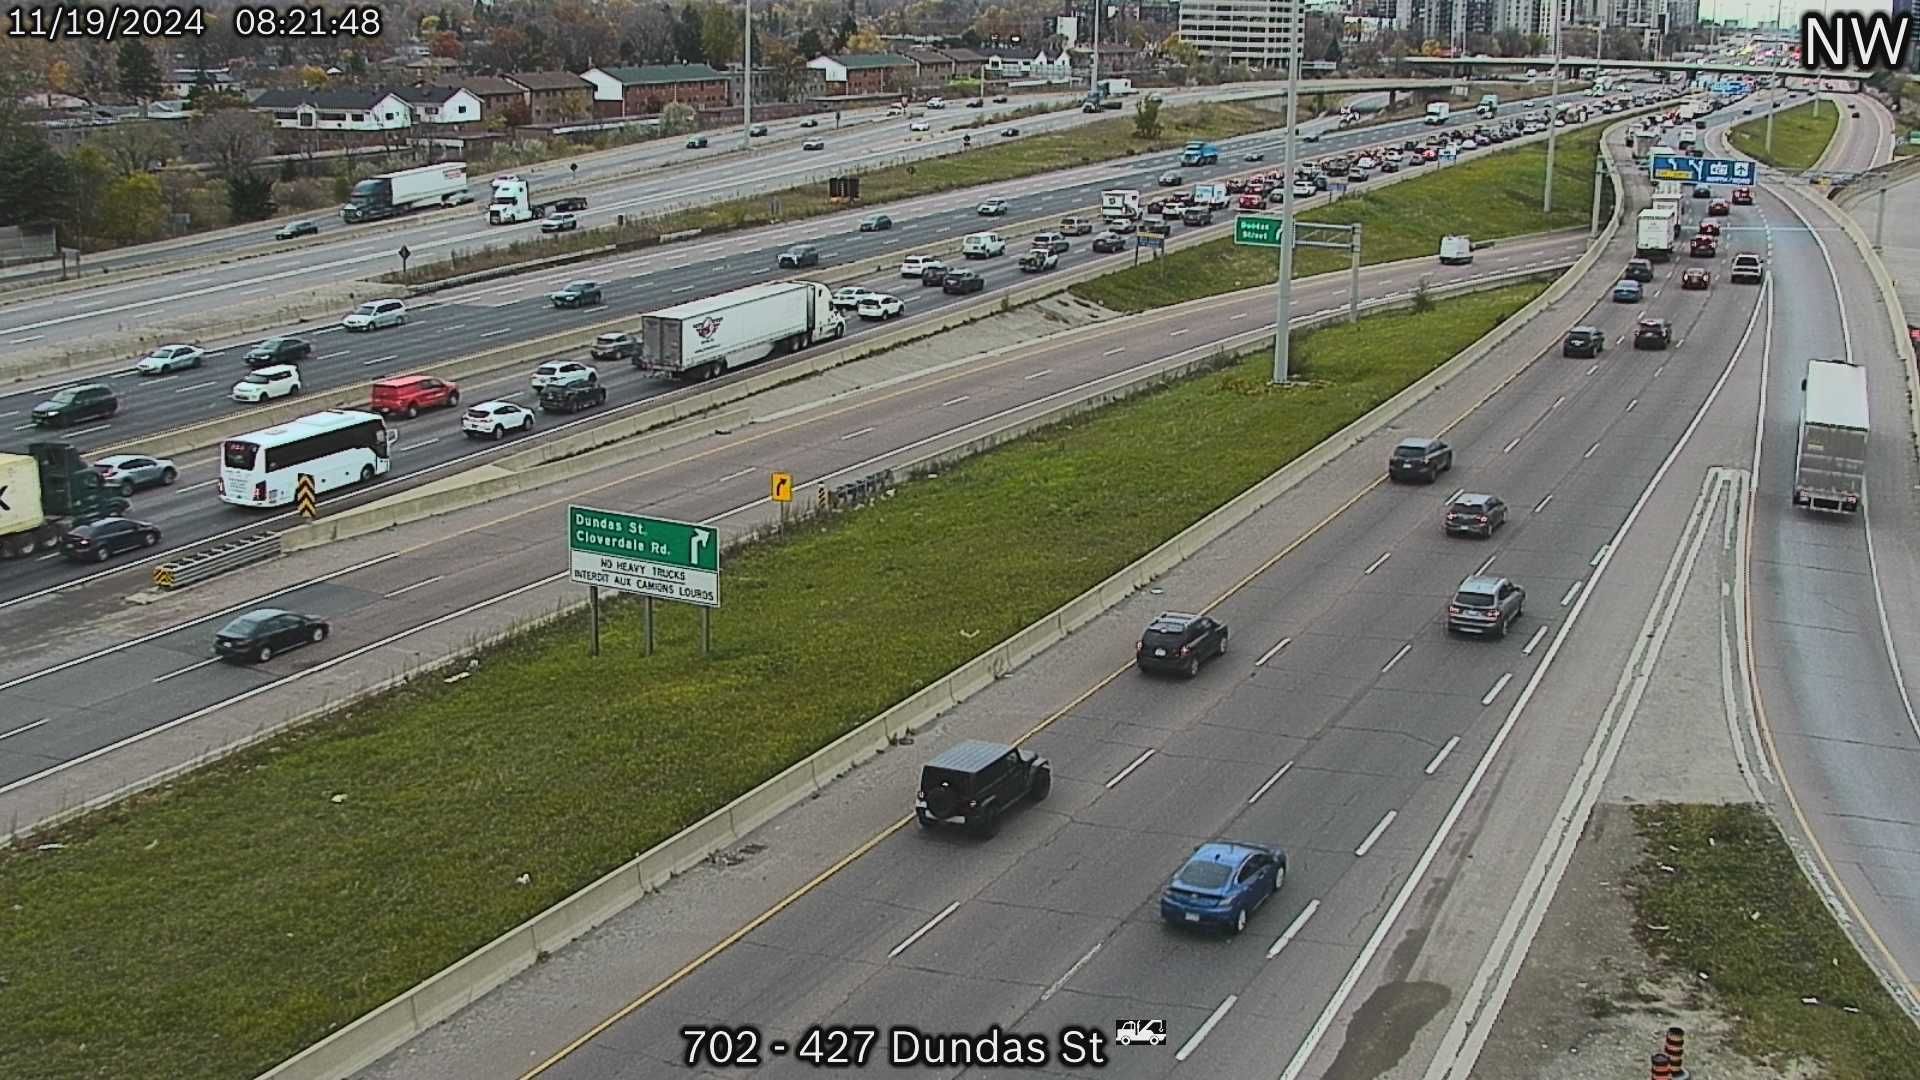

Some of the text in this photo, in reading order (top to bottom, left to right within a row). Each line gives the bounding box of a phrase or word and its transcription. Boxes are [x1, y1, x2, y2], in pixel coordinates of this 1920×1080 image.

[575, 513, 648, 536] Dundas St.
[576, 530, 672, 555] Cloverdale Rd.
[574, 569, 610, 583] INTERDIT
[614, 575, 631, 587] AUX
[636, 578, 675, 594] CAMIONS
[600, 558, 686, 581] NO HEAVY TRUCKS
